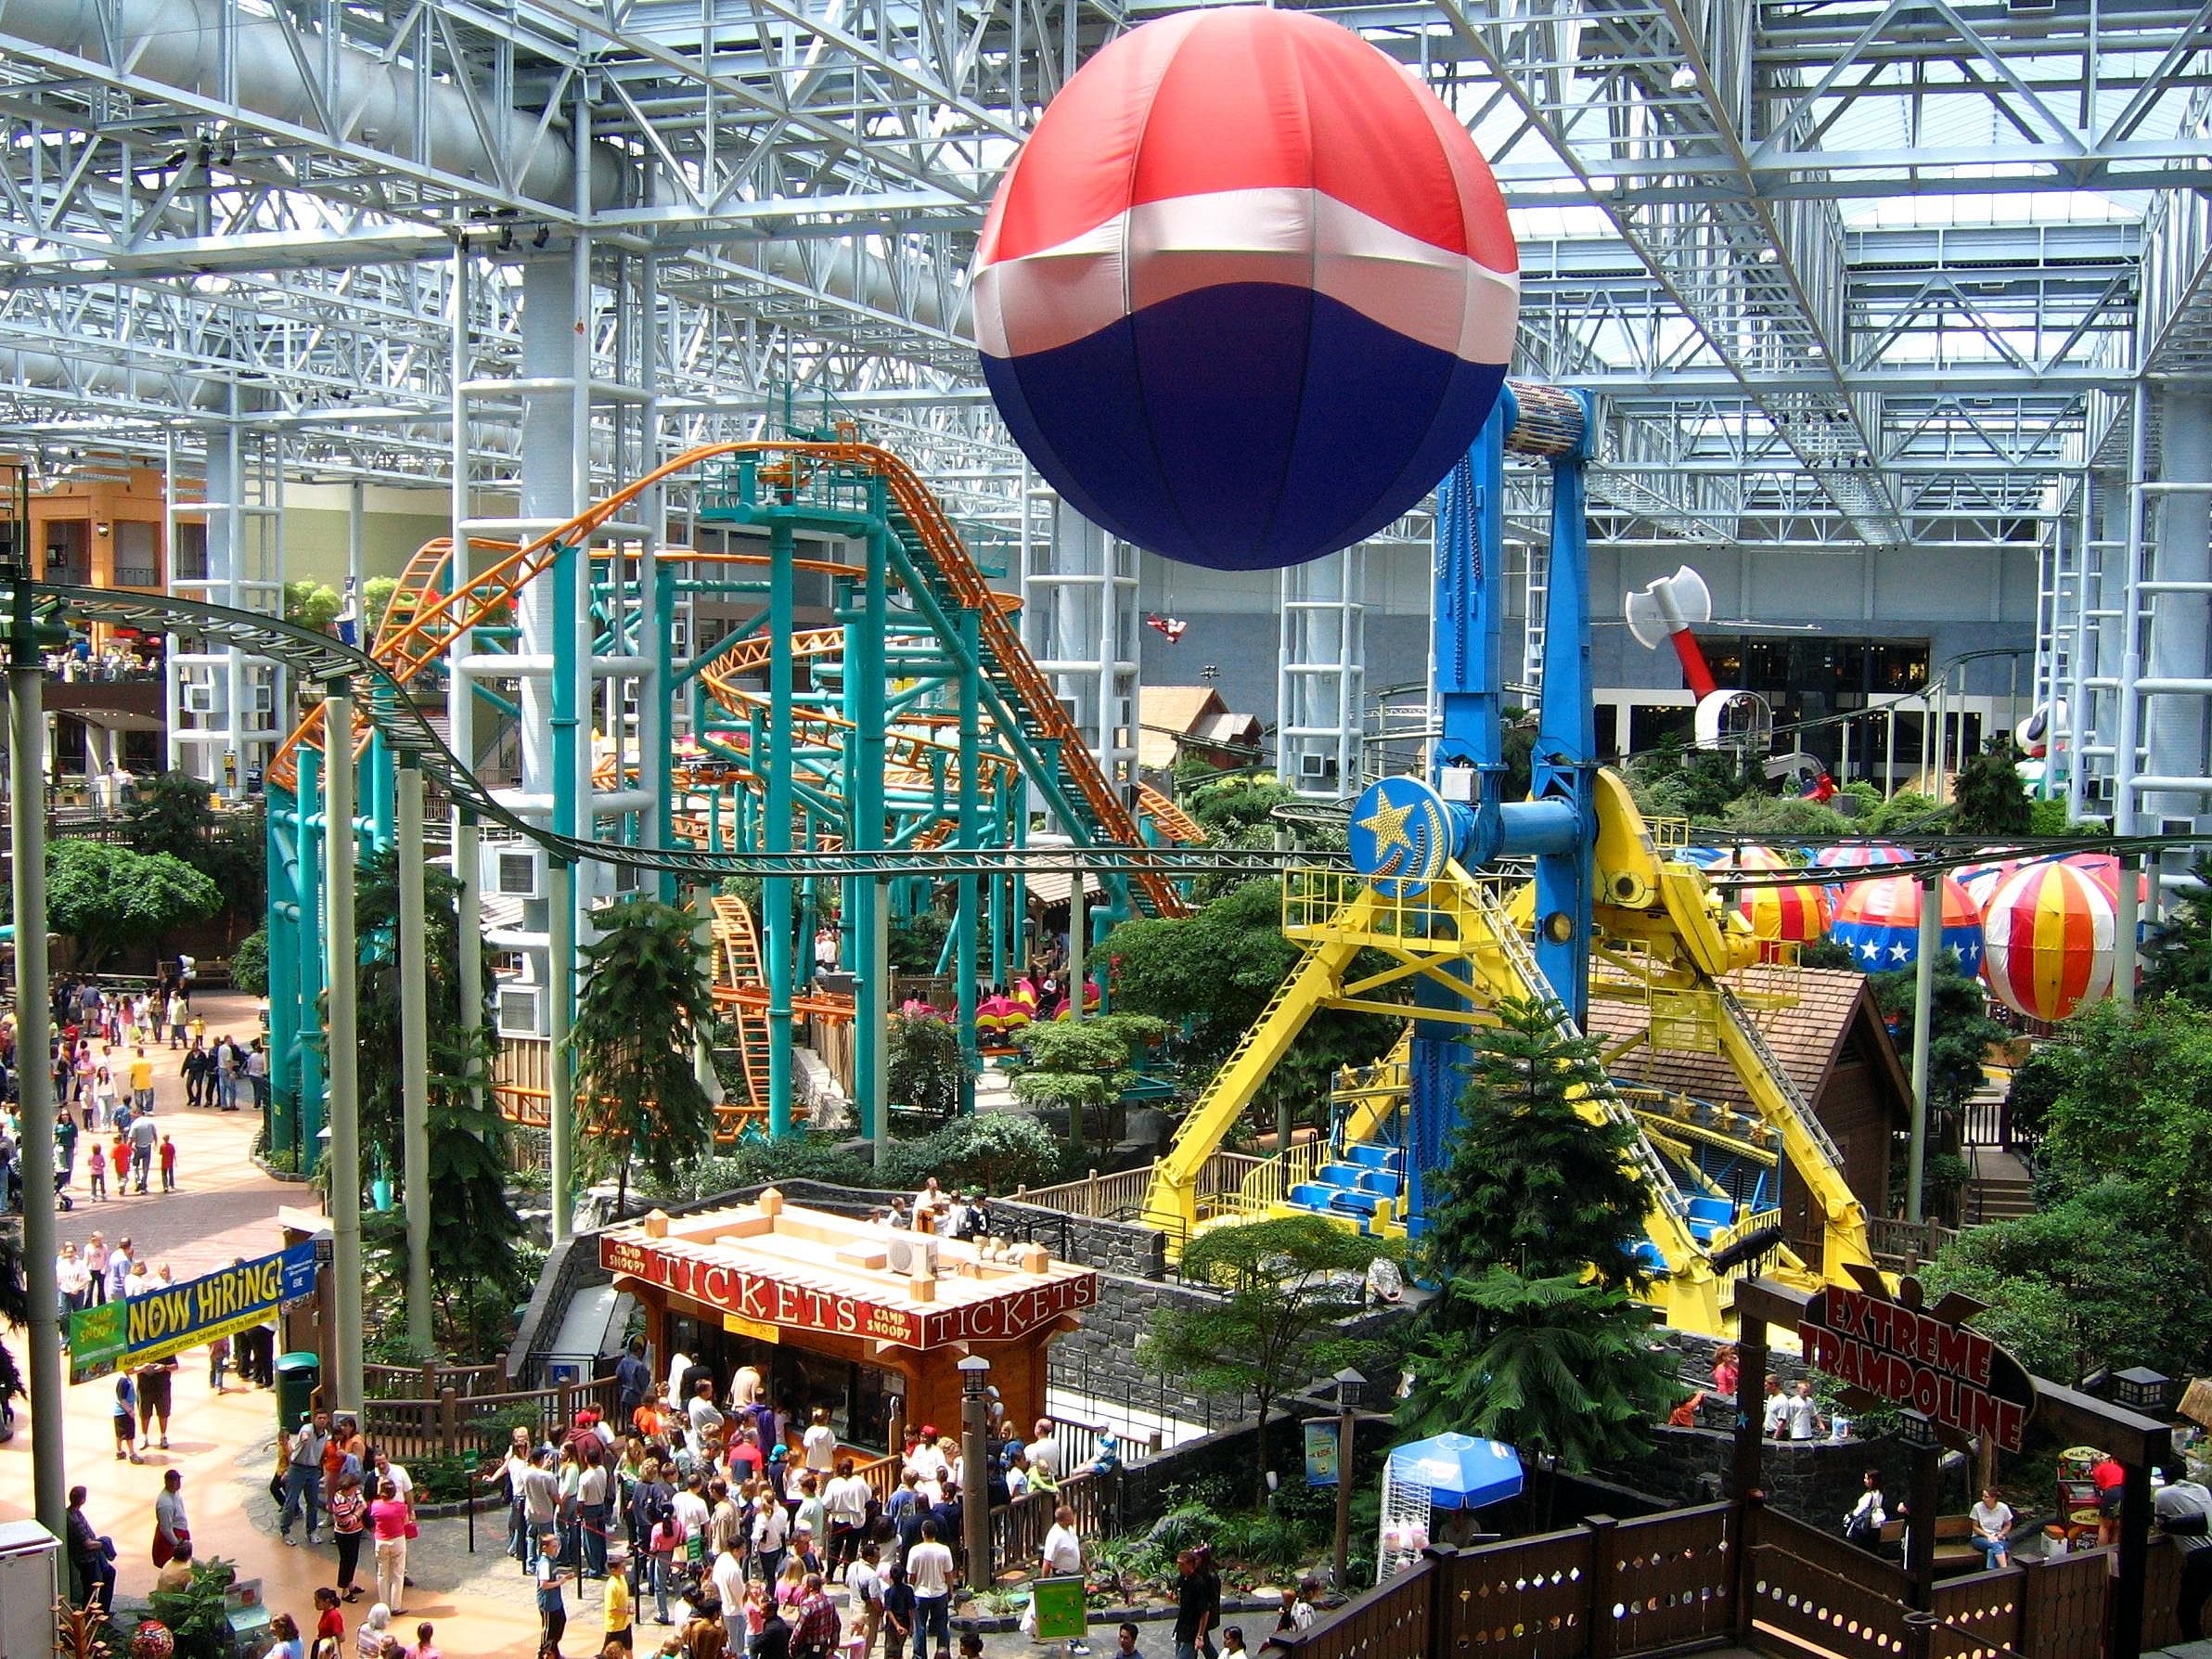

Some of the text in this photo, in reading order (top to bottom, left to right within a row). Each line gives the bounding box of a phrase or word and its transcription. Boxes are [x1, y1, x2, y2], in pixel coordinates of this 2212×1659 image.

[979, 1215, 986, 1231] 3
[609, 1254, 646, 1274] SNOOPY
[614, 1243, 641, 1262] CAMP
[656, 1254, 856, 1331] TICKETS
[932, 1278, 1090, 1342] TICKETS
[128, 1288, 192, 1345] NOW
[867, 1318, 911, 1341] SNOOPY
[874, 1308, 906, 1325] CAMP
[1826, 1284, 1995, 1388] EXTREME
[1797, 1319, 2026, 1454] TRAMPOLINE
